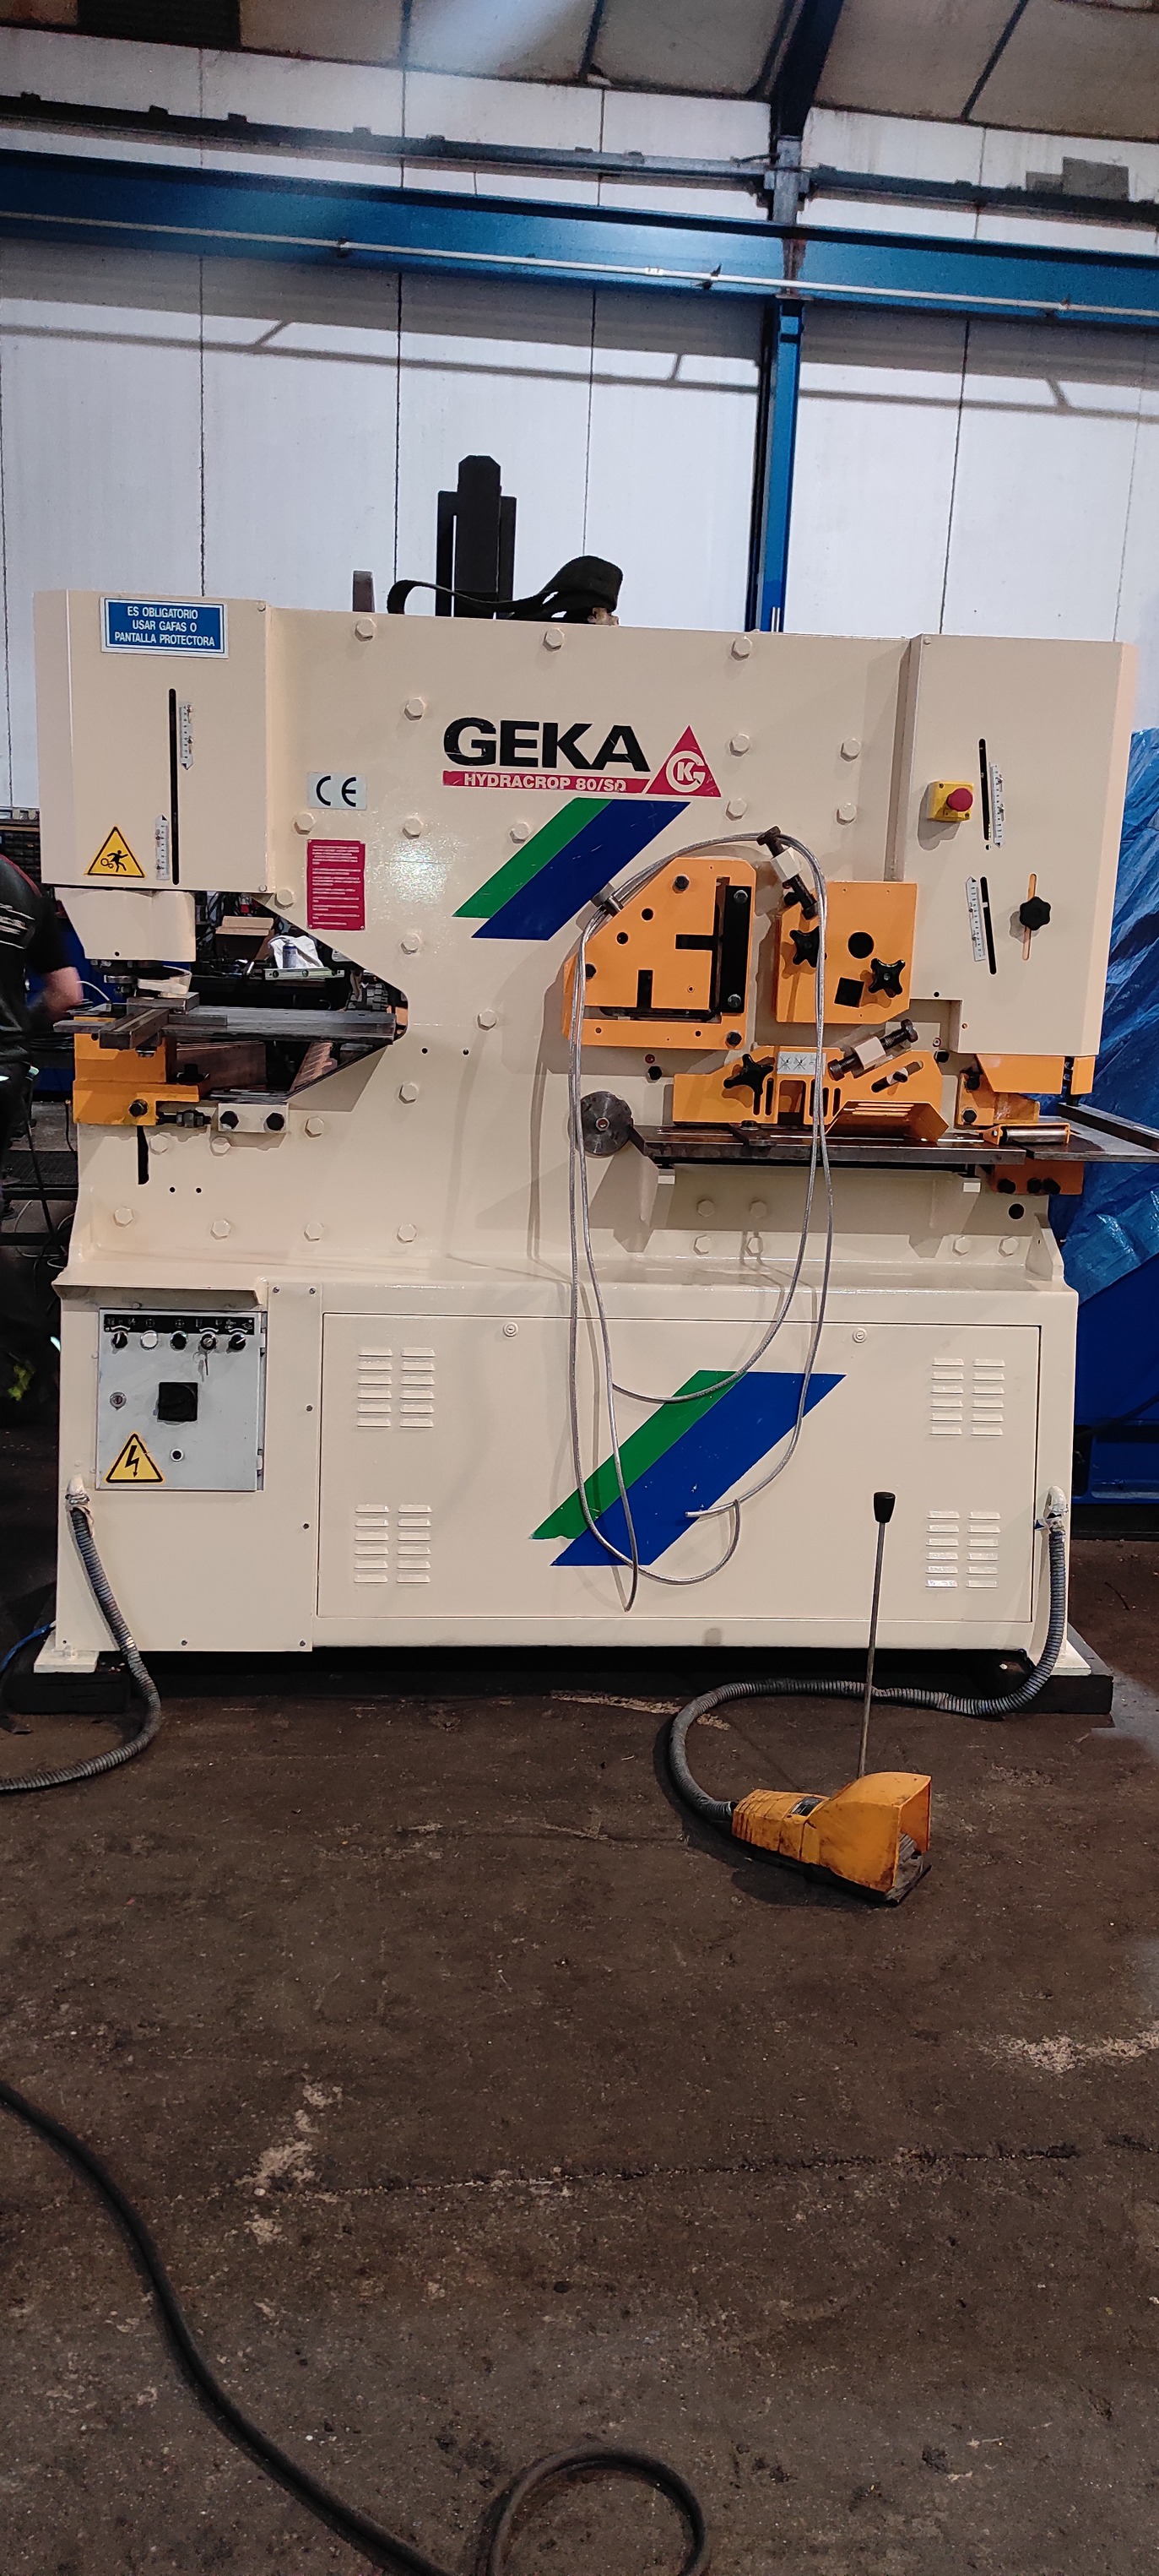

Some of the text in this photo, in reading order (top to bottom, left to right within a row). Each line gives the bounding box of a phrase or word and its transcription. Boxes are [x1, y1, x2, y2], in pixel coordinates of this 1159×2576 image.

[127, 606, 198, 620] ES OBLIGATORIO
[132, 620, 198, 632] USAR GAFAS O
[114, 632, 215, 647] PANTALLA PROTECTORA
[443, 717, 651, 773] GEKA
[464, 773, 571, 790] HYDRACROP
[316, 775, 357, 807] CE
